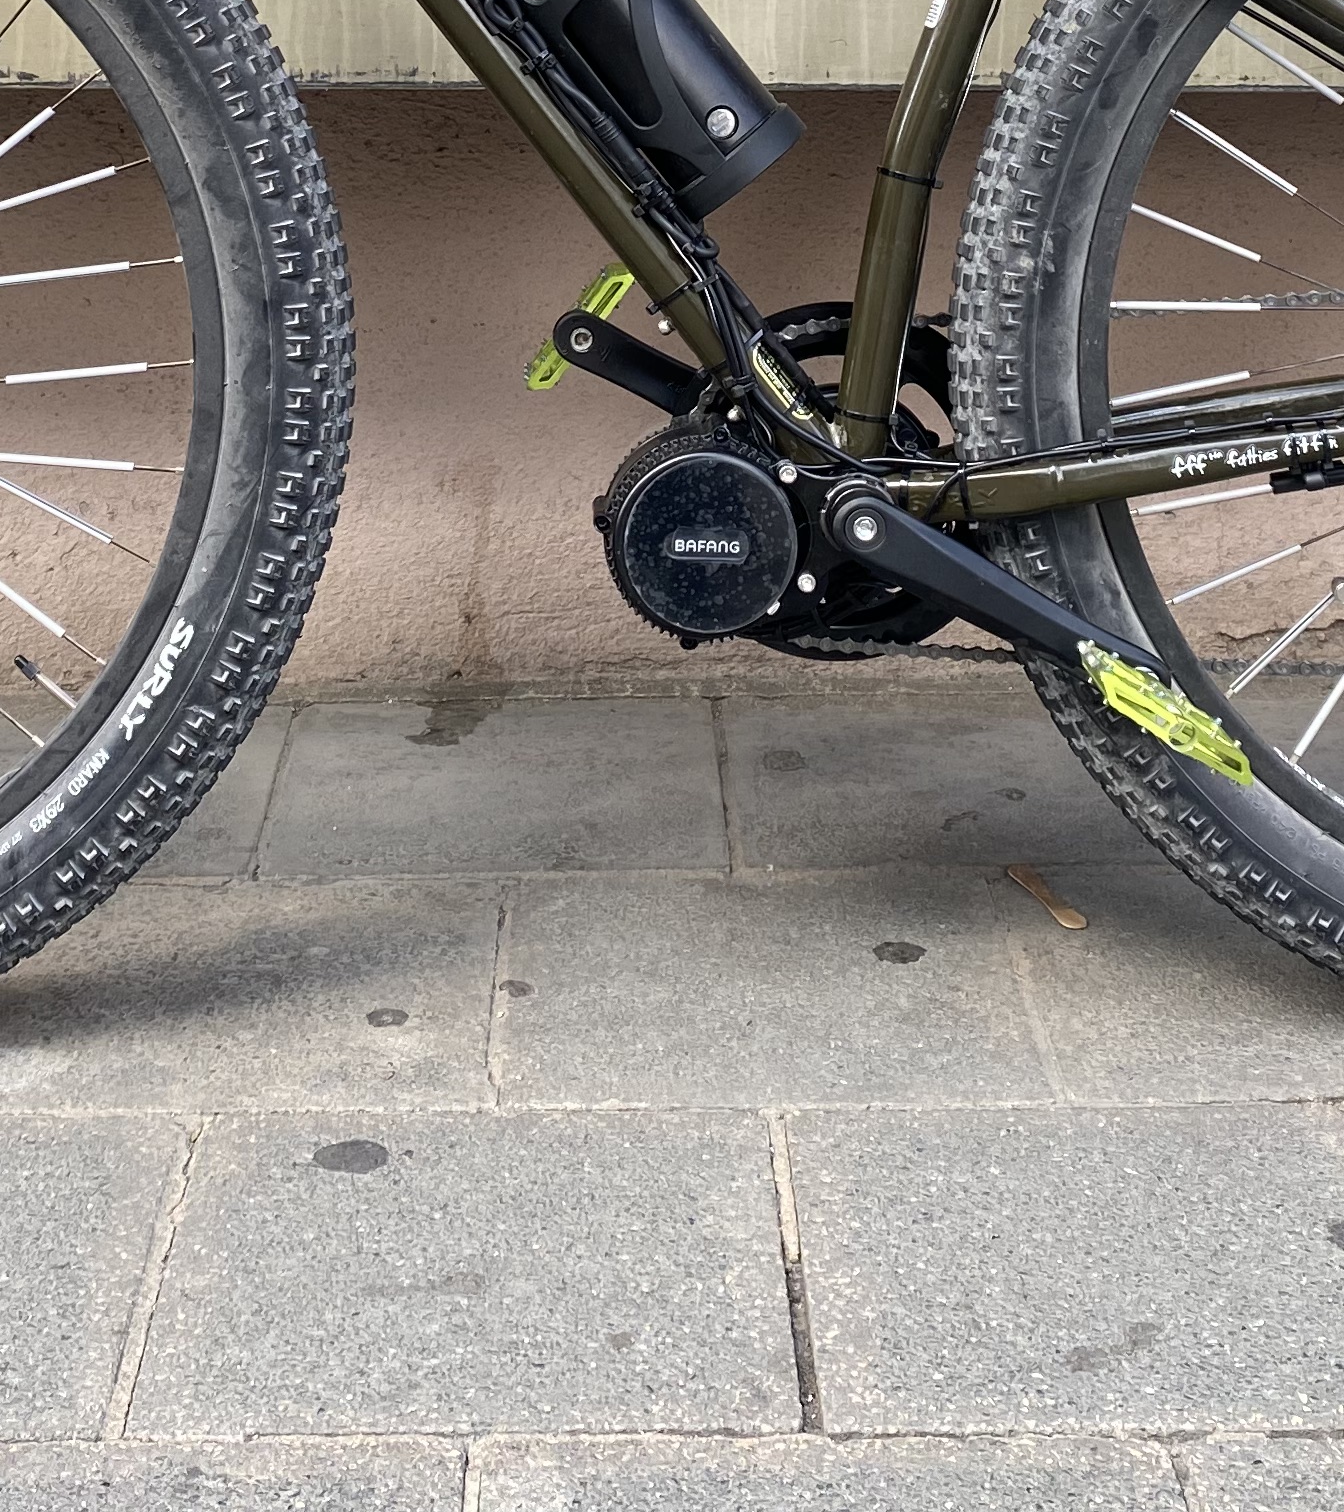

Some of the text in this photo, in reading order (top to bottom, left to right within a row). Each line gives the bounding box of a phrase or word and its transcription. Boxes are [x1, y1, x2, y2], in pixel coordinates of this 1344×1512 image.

[1225, 443, 1279, 469] fatties
[674, 539, 740, 554] BAFANG
[119, 617, 195, 741] SURLY
[67, 747, 110, 797] KNARD
